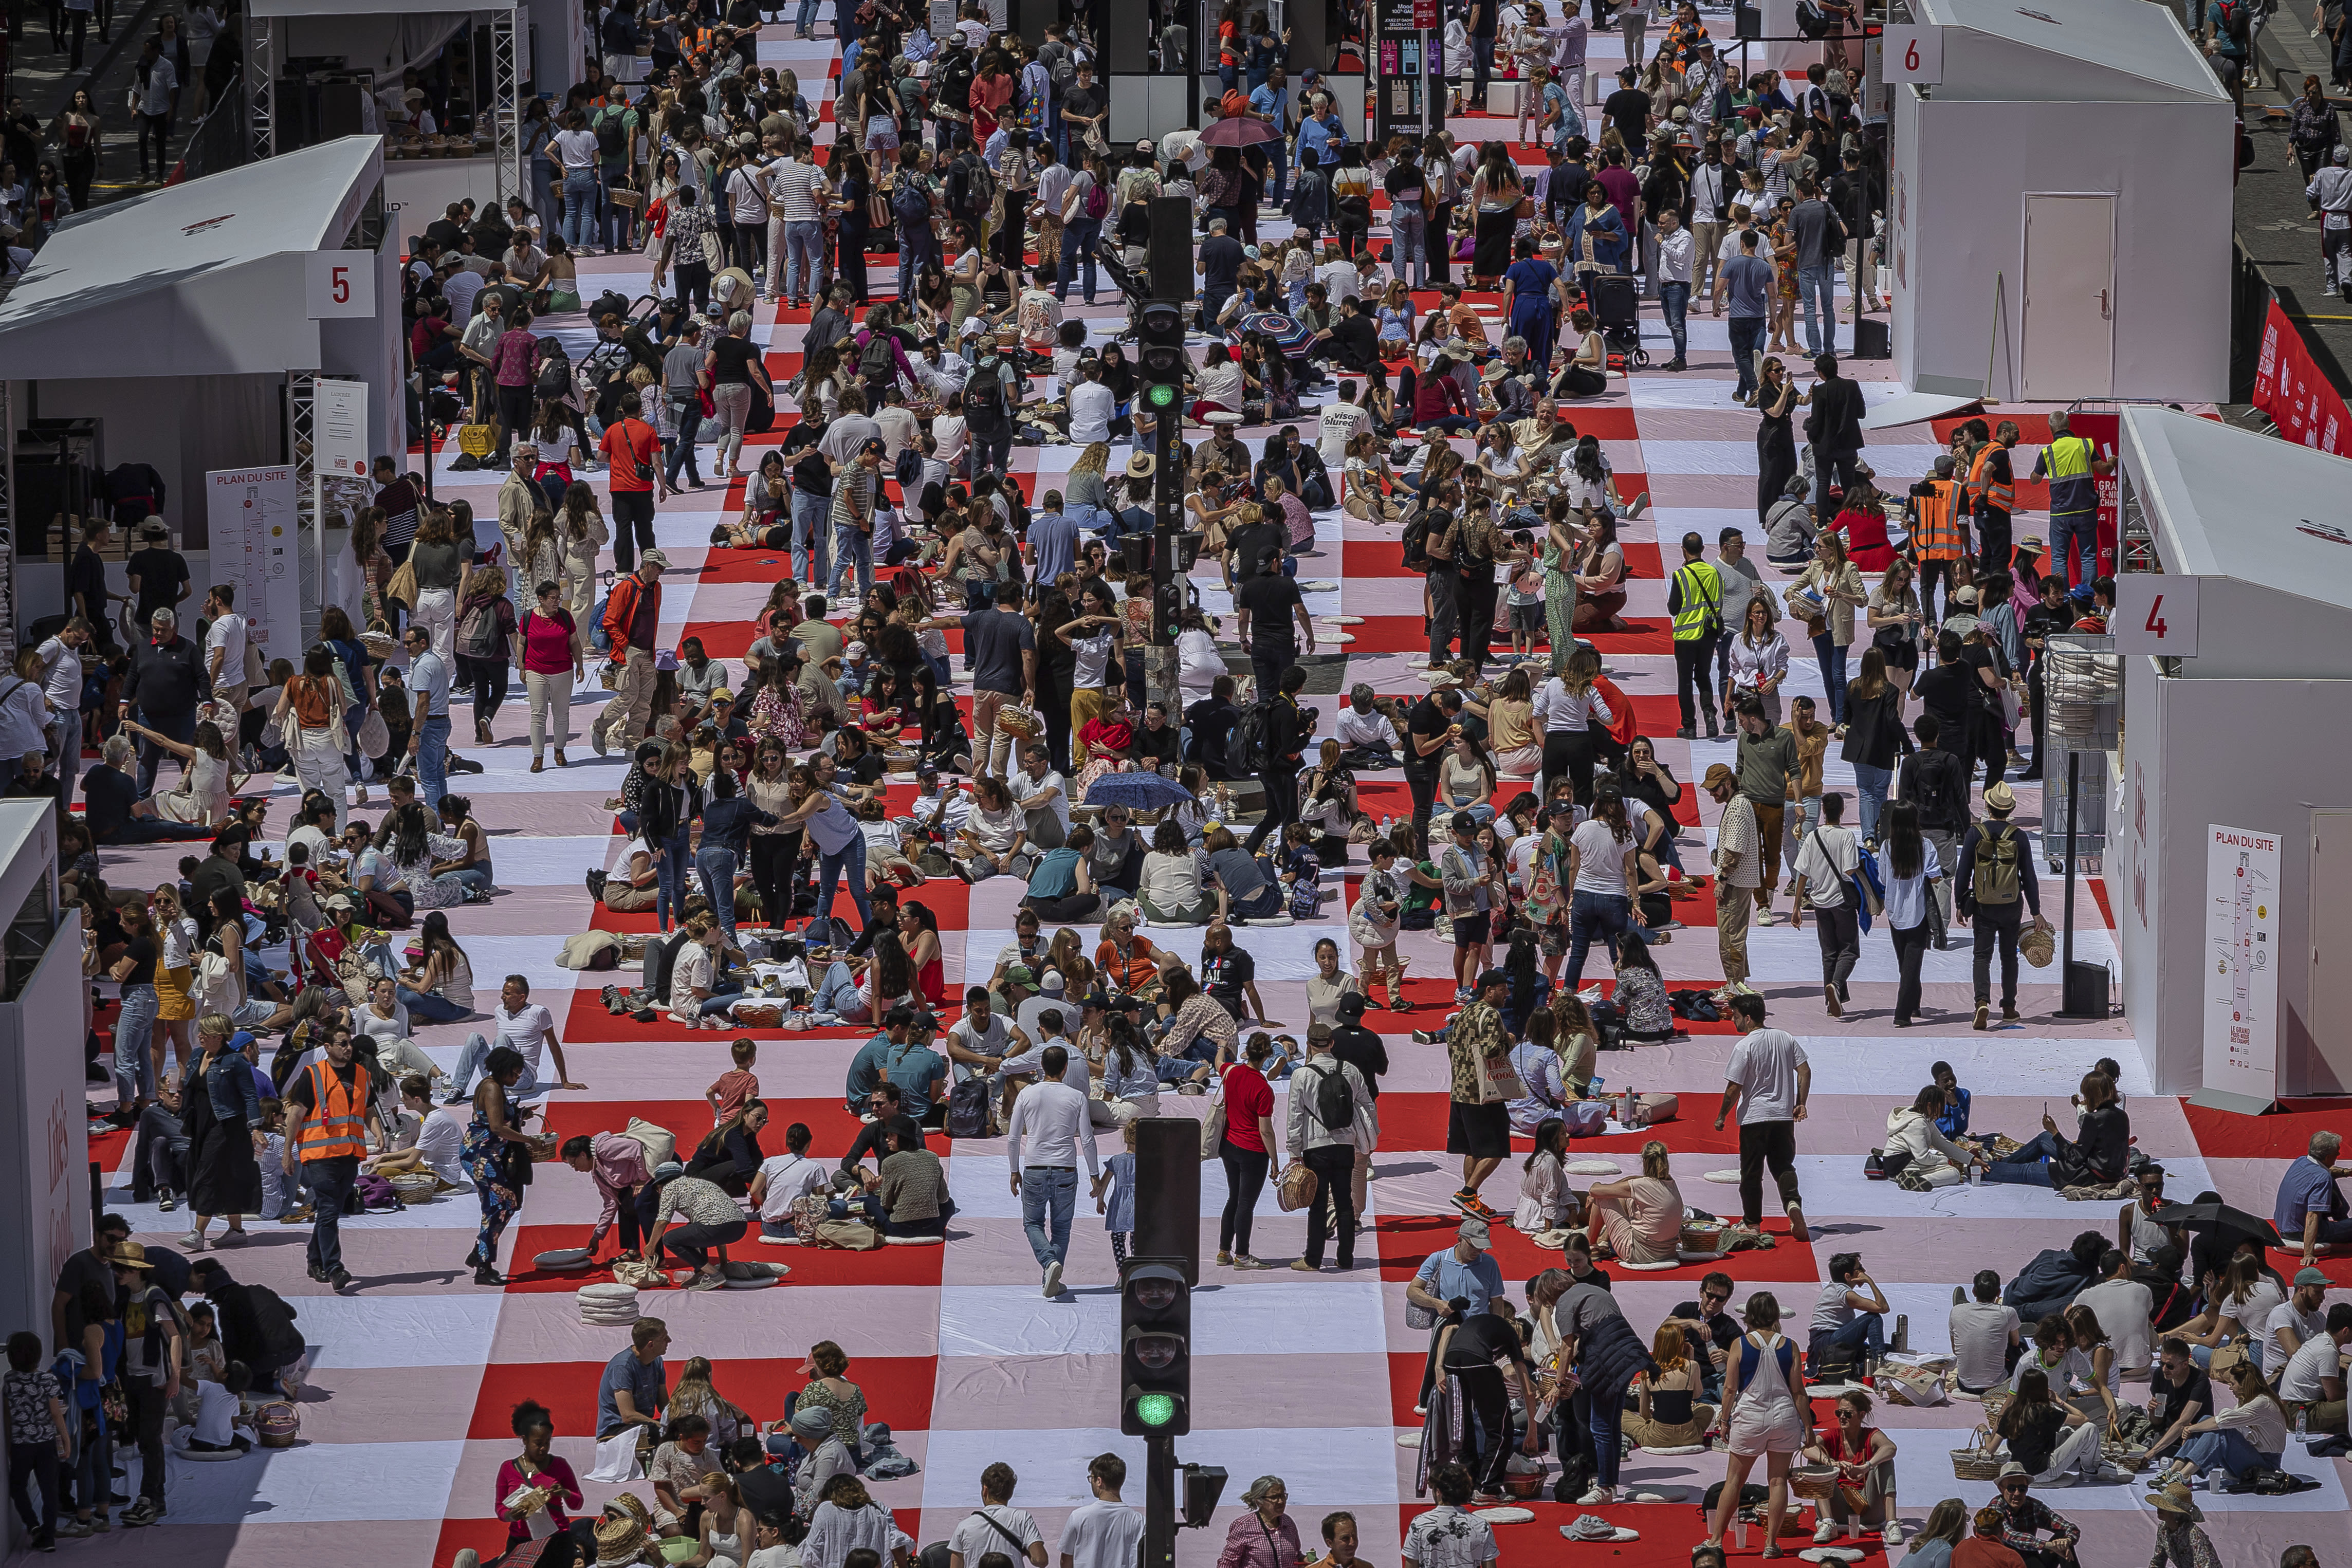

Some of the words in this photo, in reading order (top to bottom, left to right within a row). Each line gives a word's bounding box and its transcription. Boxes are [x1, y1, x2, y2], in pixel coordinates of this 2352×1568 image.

[1905, 39, 1920, 71] 6
[332, 267, 351, 304] 5
[216, 474, 245, 486] PLAN
[247, 472, 262, 483] DU
[265, 471, 287, 481] SITE
[2099, 481, 2117, 491] GRA
[2145, 595, 2167, 639] 4
[2216, 832, 2239, 846] PLAN
[2241, 836, 2254, 848] DU
[2255, 839, 2274, 851] SITE
[1310, 863, 1318, 883] 7
[2236, 1026, 2250, 1035] GRAND
[1487, 1068, 1515, 1081] Good
